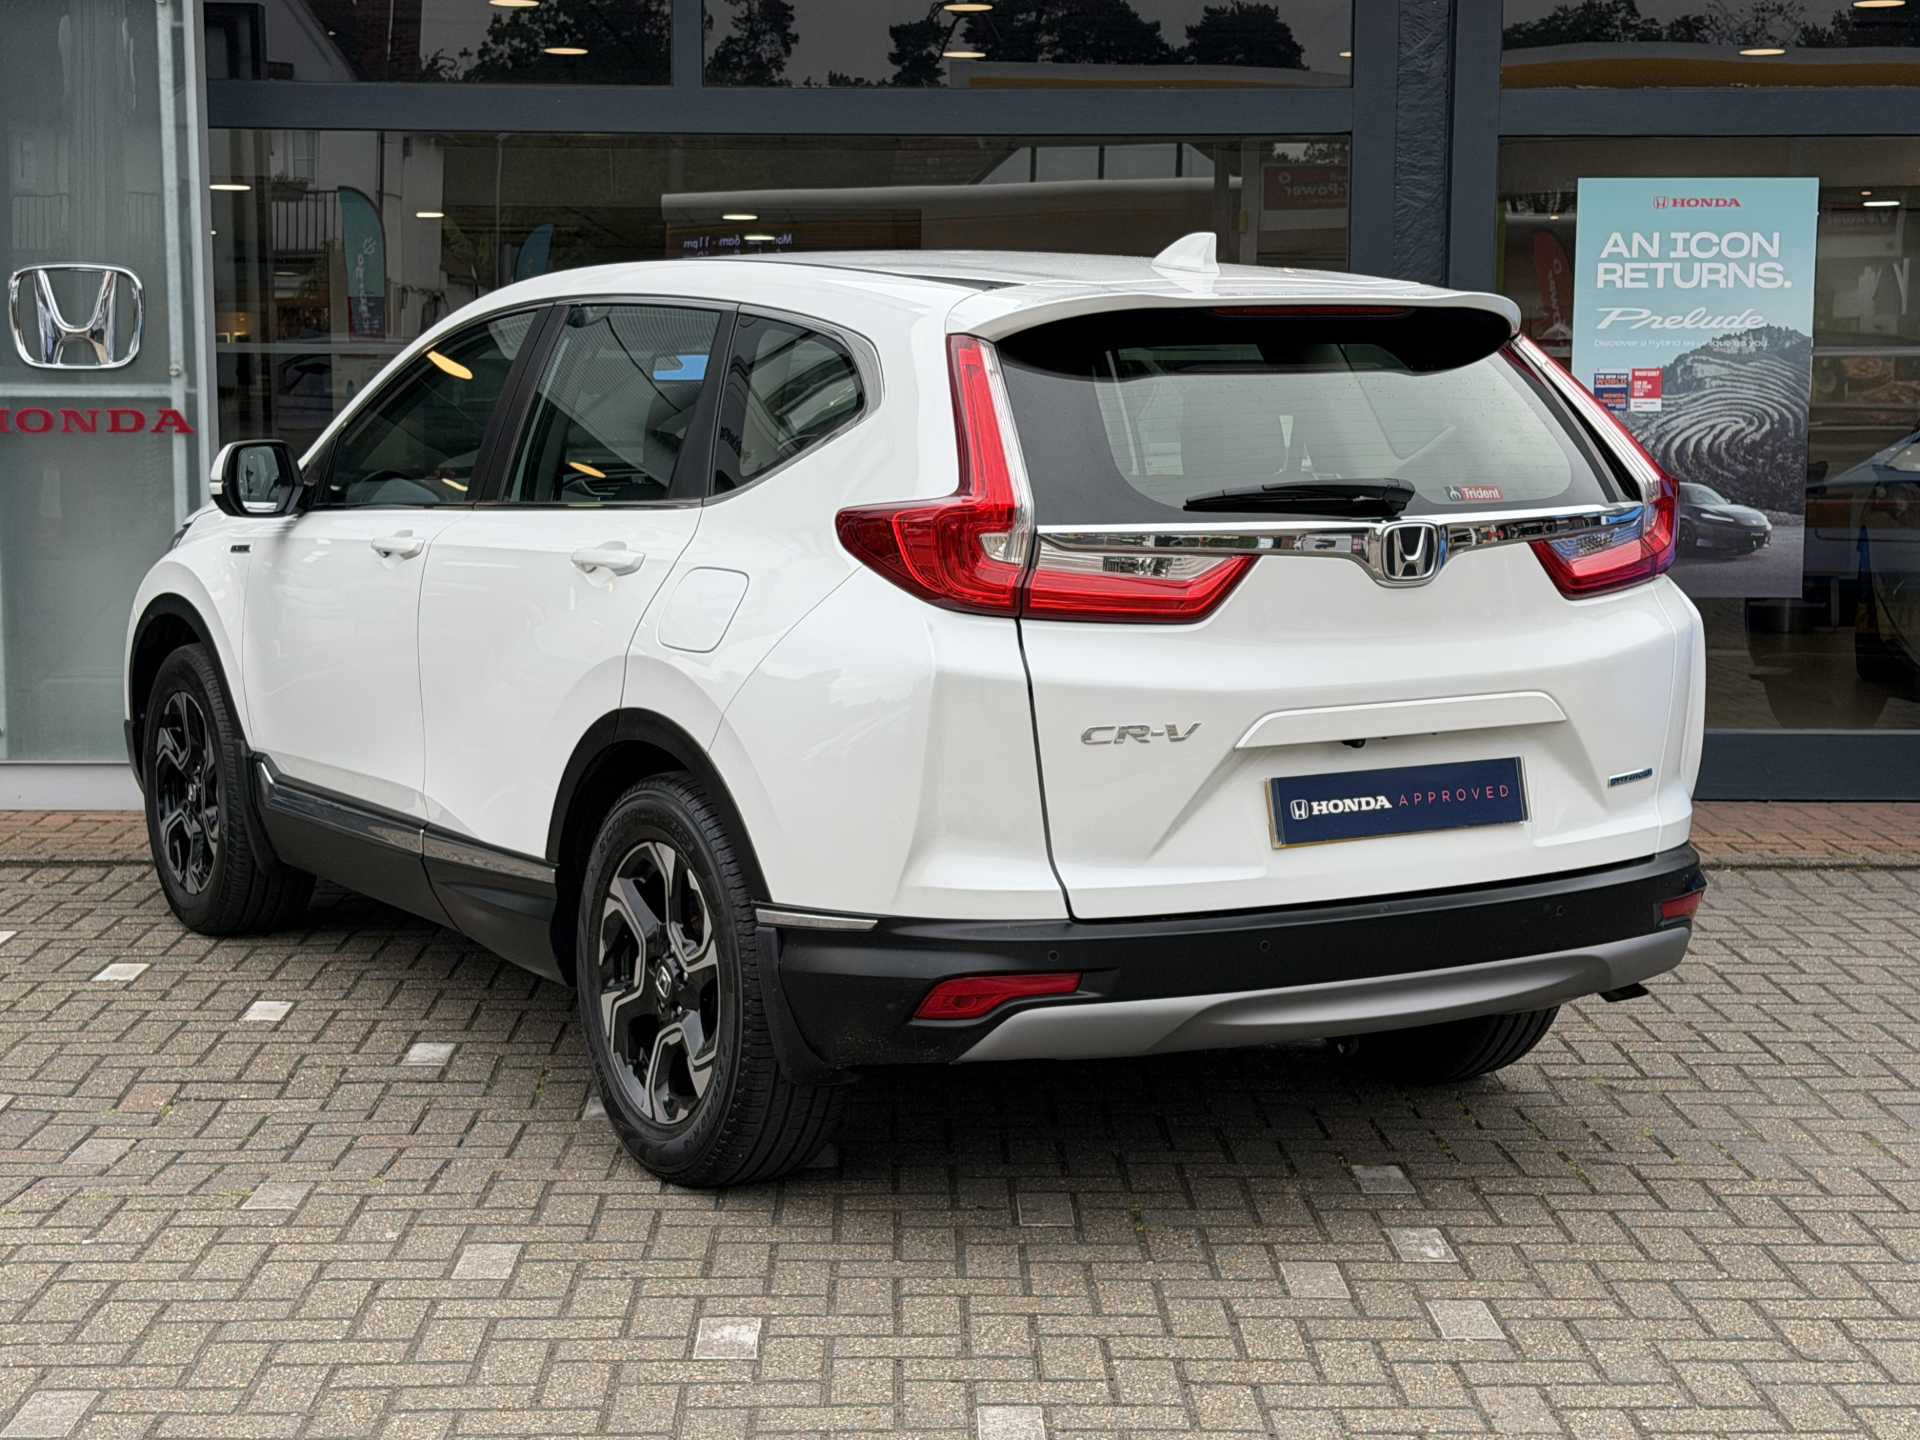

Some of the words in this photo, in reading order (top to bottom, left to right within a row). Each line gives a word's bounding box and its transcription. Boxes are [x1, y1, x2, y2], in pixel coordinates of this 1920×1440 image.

[1672, 197, 1742, 208] HONDA
[1600, 231, 1660, 258] AN
[1670, 231, 1780, 259] ICON
[1596, 262, 1793, 289] RETURNS.
[1596, 306, 1767, 330] Prelude
[0, 407, 194, 434] ONDA
[1460, 486, 1501, 499] Trident
[1080, 721, 1202, 745] CR-V
[1311, 795, 1393, 815] HONDA
[1399, 784, 1511, 807] APPROVED
